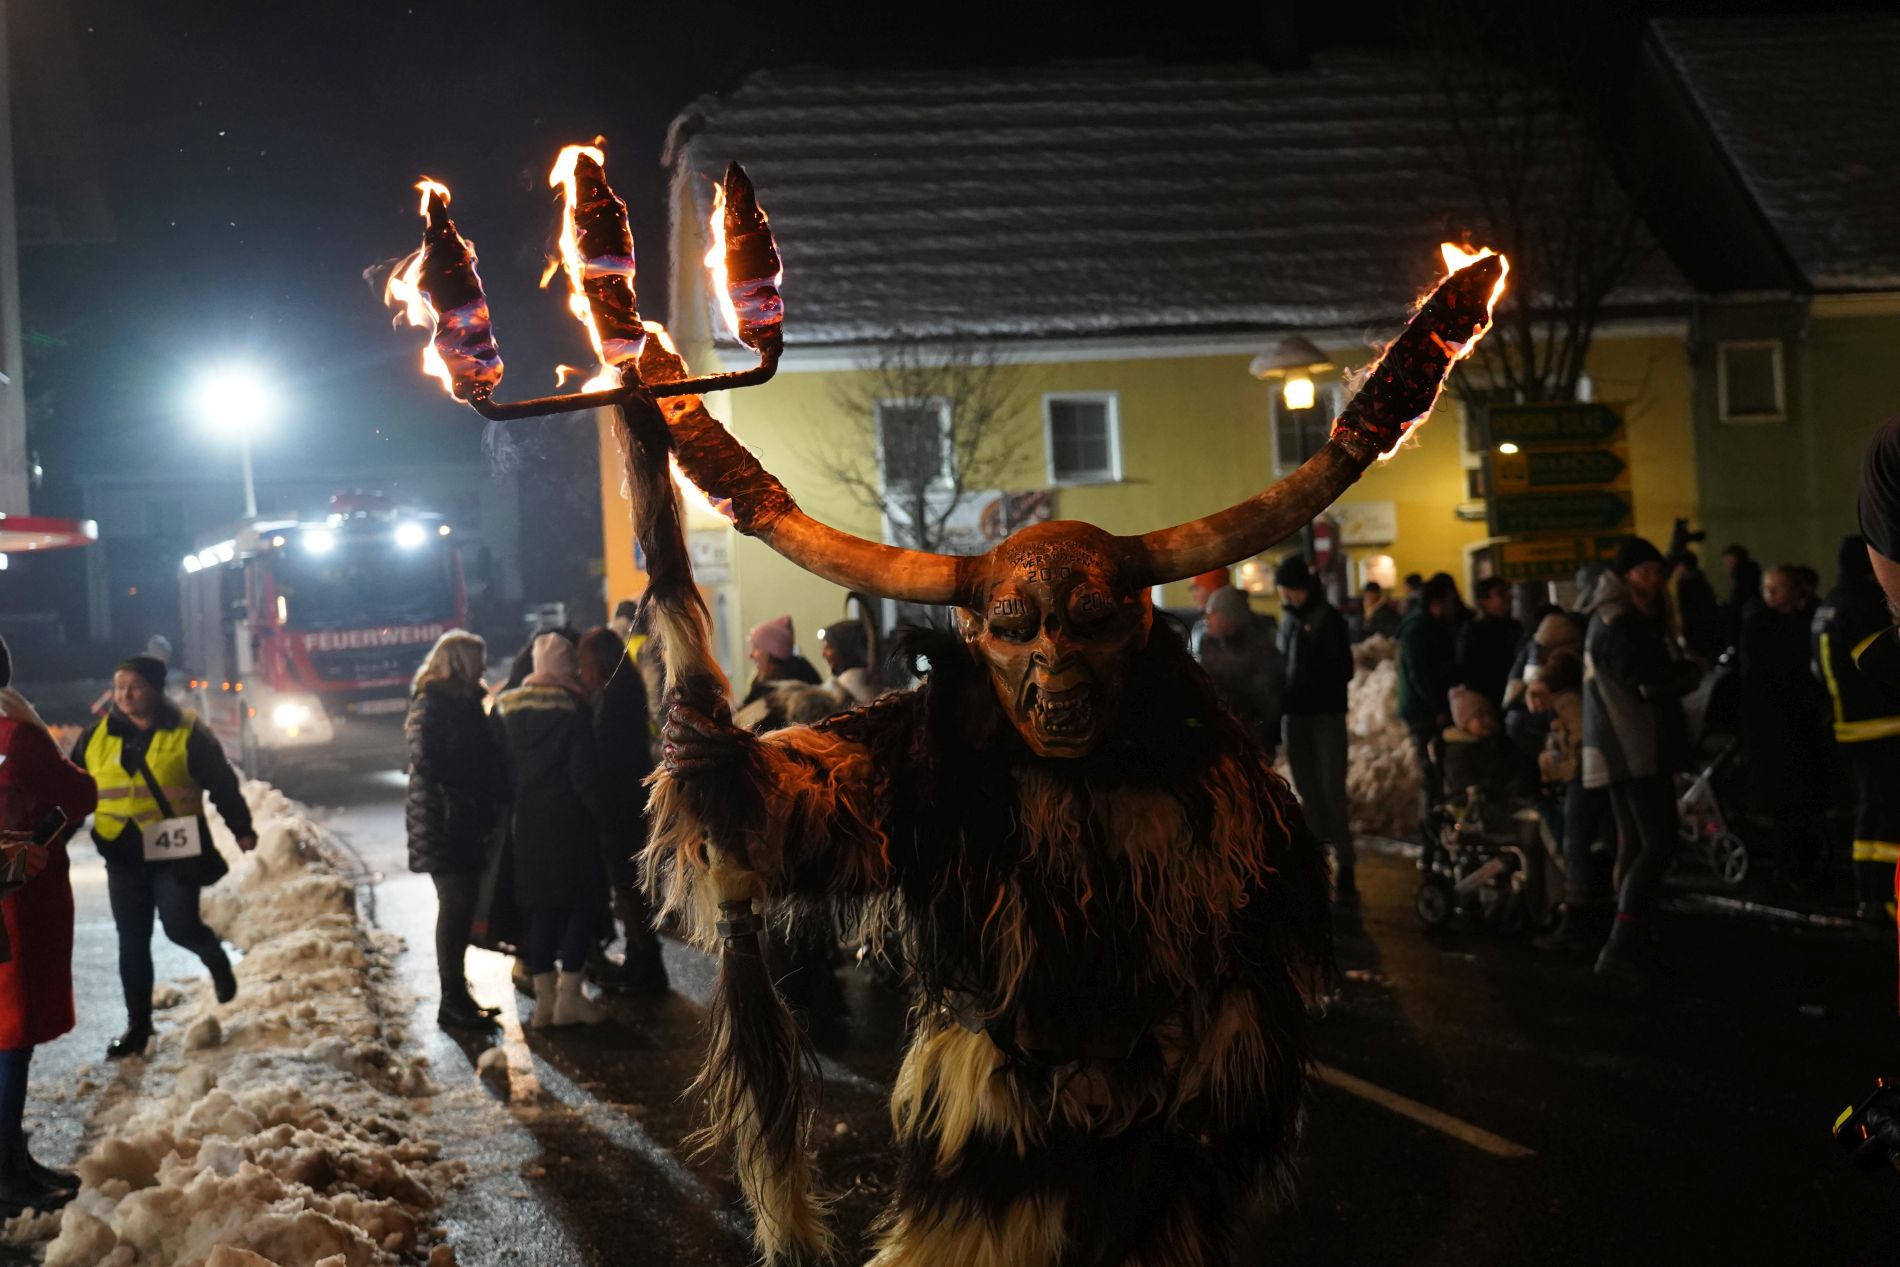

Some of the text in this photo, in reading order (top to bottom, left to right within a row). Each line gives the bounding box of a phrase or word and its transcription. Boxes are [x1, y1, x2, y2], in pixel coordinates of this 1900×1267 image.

[1028, 567, 1071, 583] 2010
[994, 598, 1026, 616] 2011
[304, 623, 443, 652] FEUERWEHR
[155, 827, 187, 850] 45
